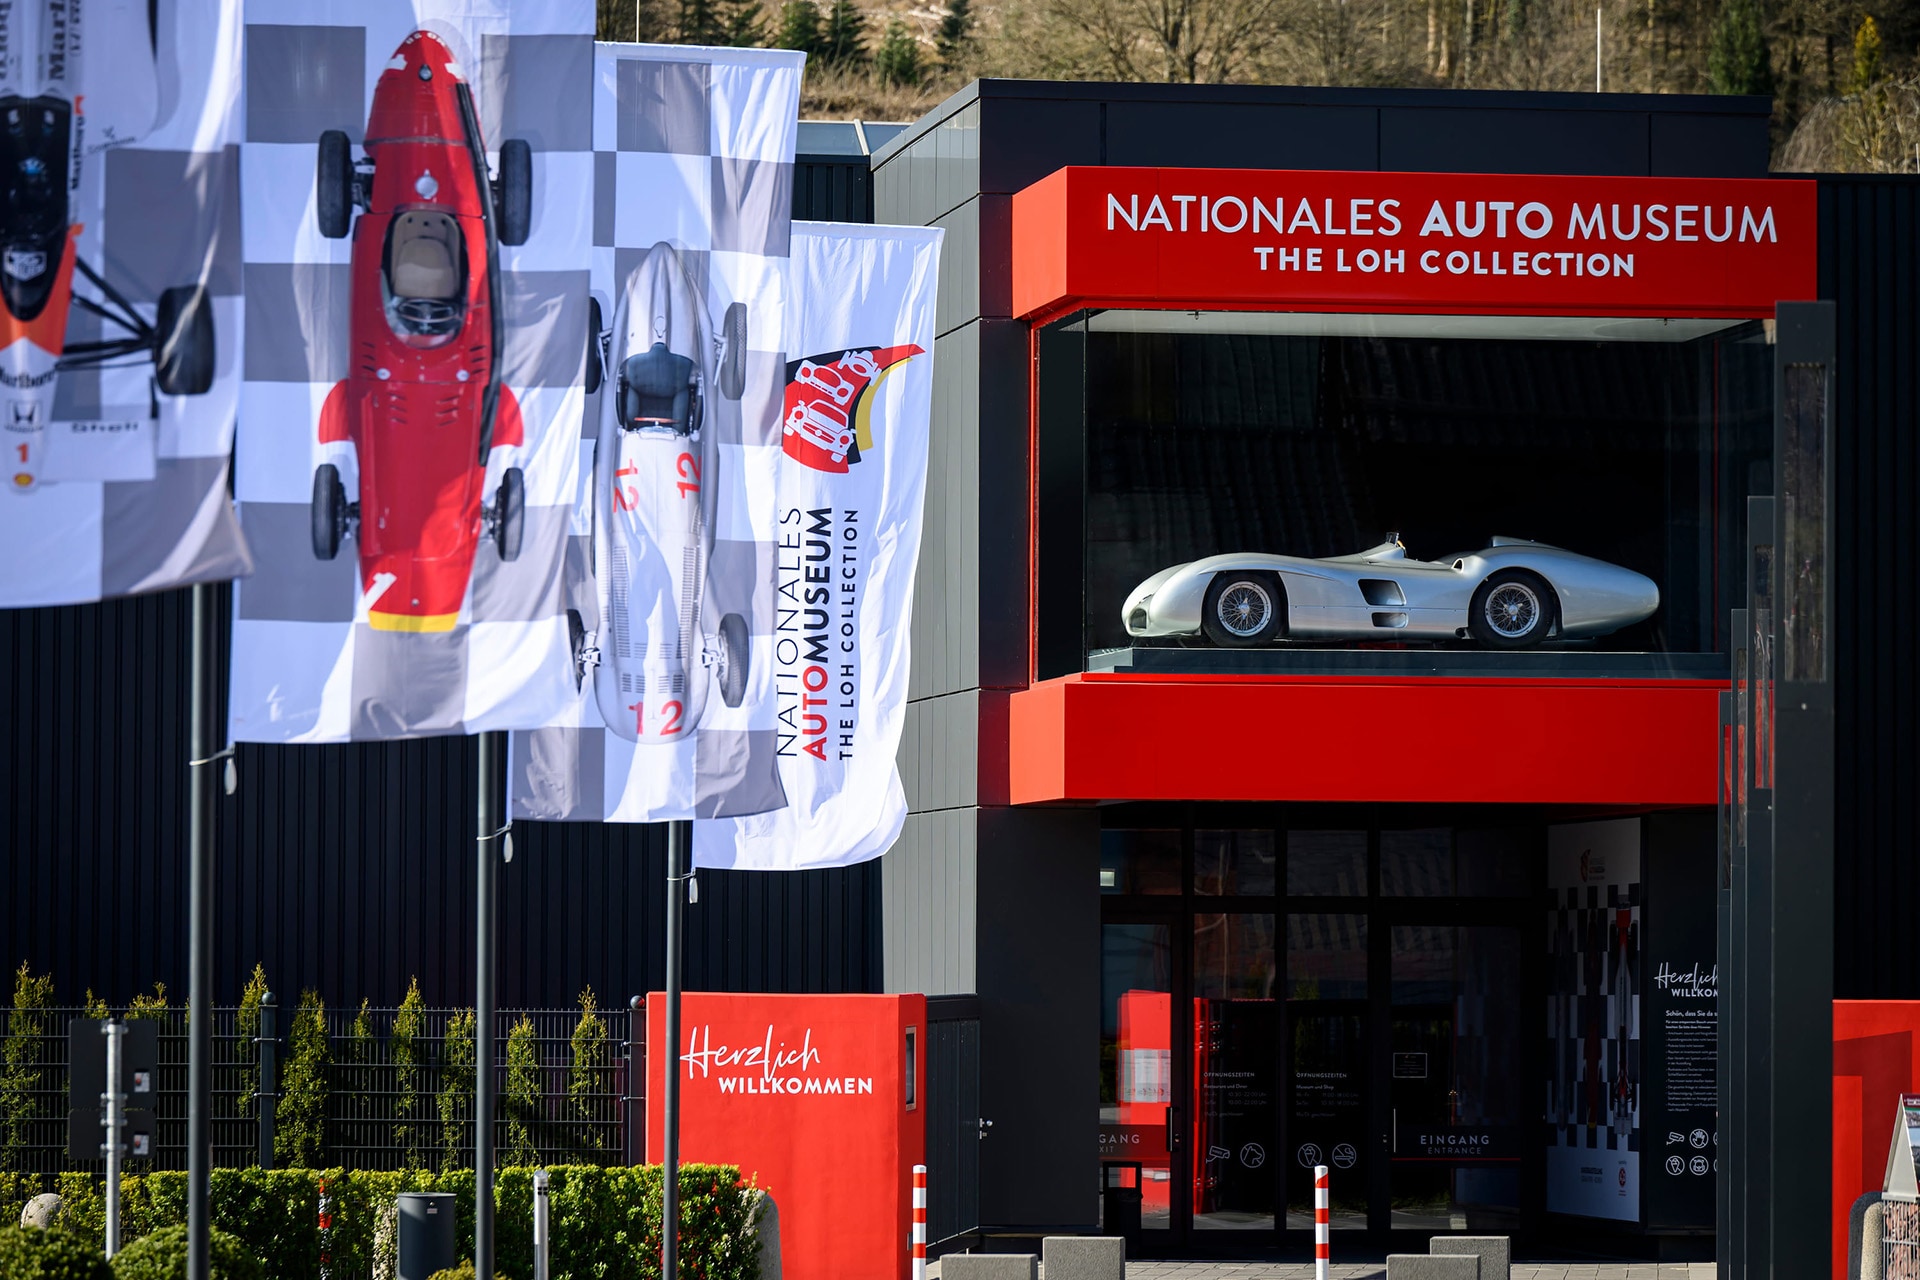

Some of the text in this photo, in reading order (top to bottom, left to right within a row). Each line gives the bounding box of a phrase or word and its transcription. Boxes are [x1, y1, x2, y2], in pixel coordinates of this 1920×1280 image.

[1107, 193, 1779, 244] NATIONALES AUTO MUSEUM
[1254, 247, 1635, 279] THE LOH COLLECTION
[16, 442, 30, 464] 1
[675, 451, 702, 500] 12
[612, 457, 640, 514] 12
[775, 507, 802, 757] NATIONALES
[802, 507, 833, 763] AUTOMUSEUM
[839, 510, 859, 762] THE LOH COLLECTION
[680, 1024, 821, 1083] Herzlich
[717, 1076, 874, 1095] WILLKOMMEN
[1420, 1135, 1490, 1145] EINGANG
[1427, 1147, 1482, 1155] ENTRANCE
